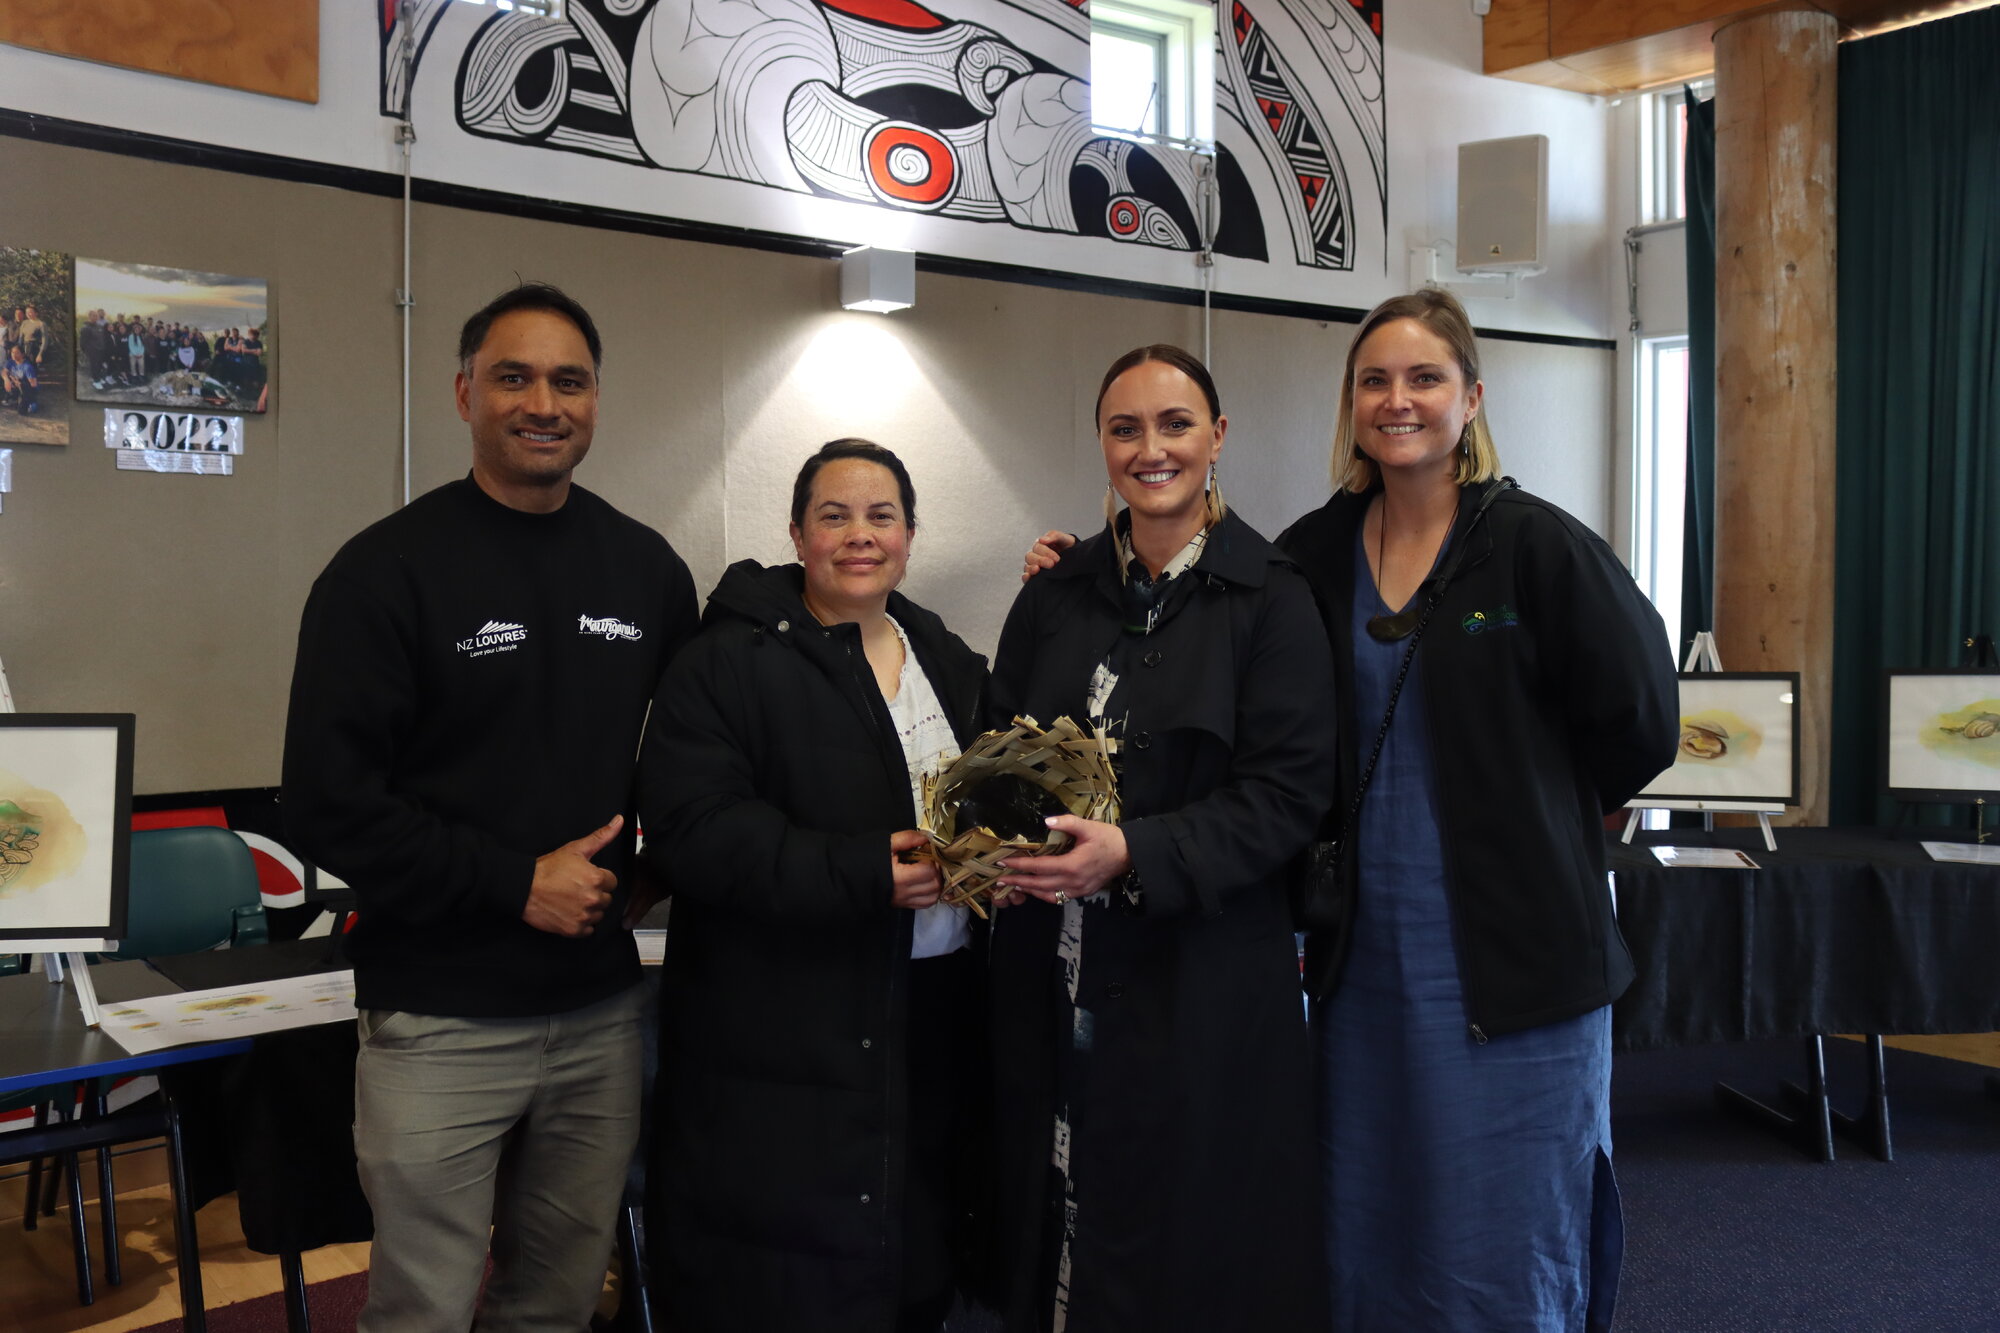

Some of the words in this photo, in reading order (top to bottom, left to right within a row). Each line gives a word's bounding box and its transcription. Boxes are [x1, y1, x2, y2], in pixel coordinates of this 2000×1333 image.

[122, 412, 228, 451] 2022
[456, 639, 474, 652] NZ
[476, 630, 526, 647] LOUVRES
[470, 650, 483, 658] Love
[484, 648, 495, 656] your
[496, 644, 517, 653] Lifestyle
